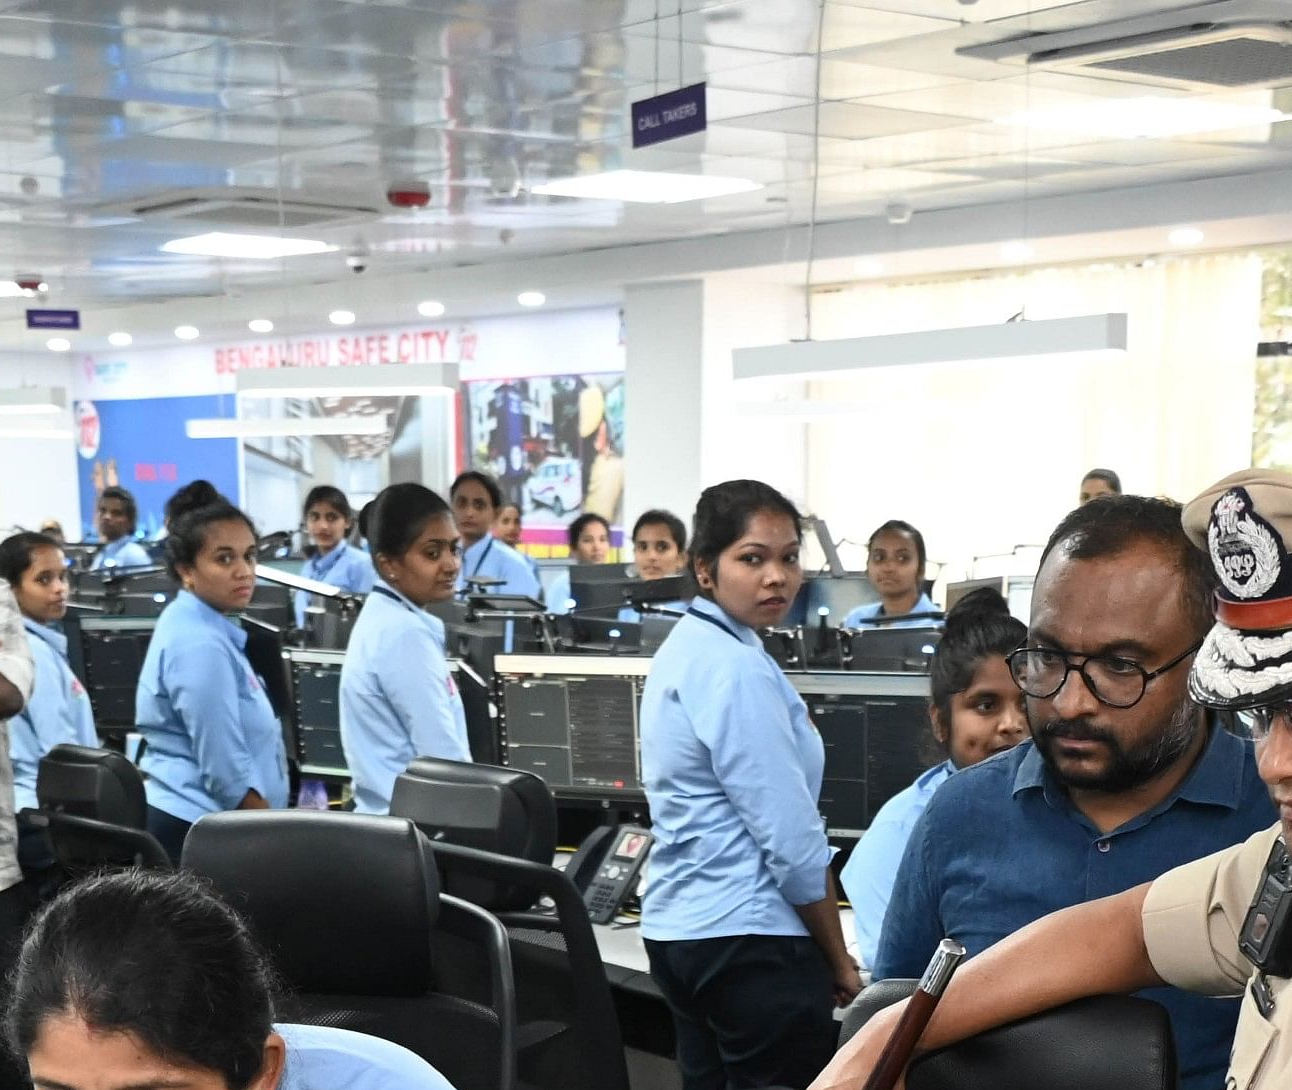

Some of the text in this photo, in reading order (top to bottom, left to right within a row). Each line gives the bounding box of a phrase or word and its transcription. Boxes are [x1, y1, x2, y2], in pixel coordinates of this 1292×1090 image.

[638, 102, 697, 131] CALL TAKERS
[339, 335, 389, 365] SAFE
[398, 330, 450, 362] CITY
